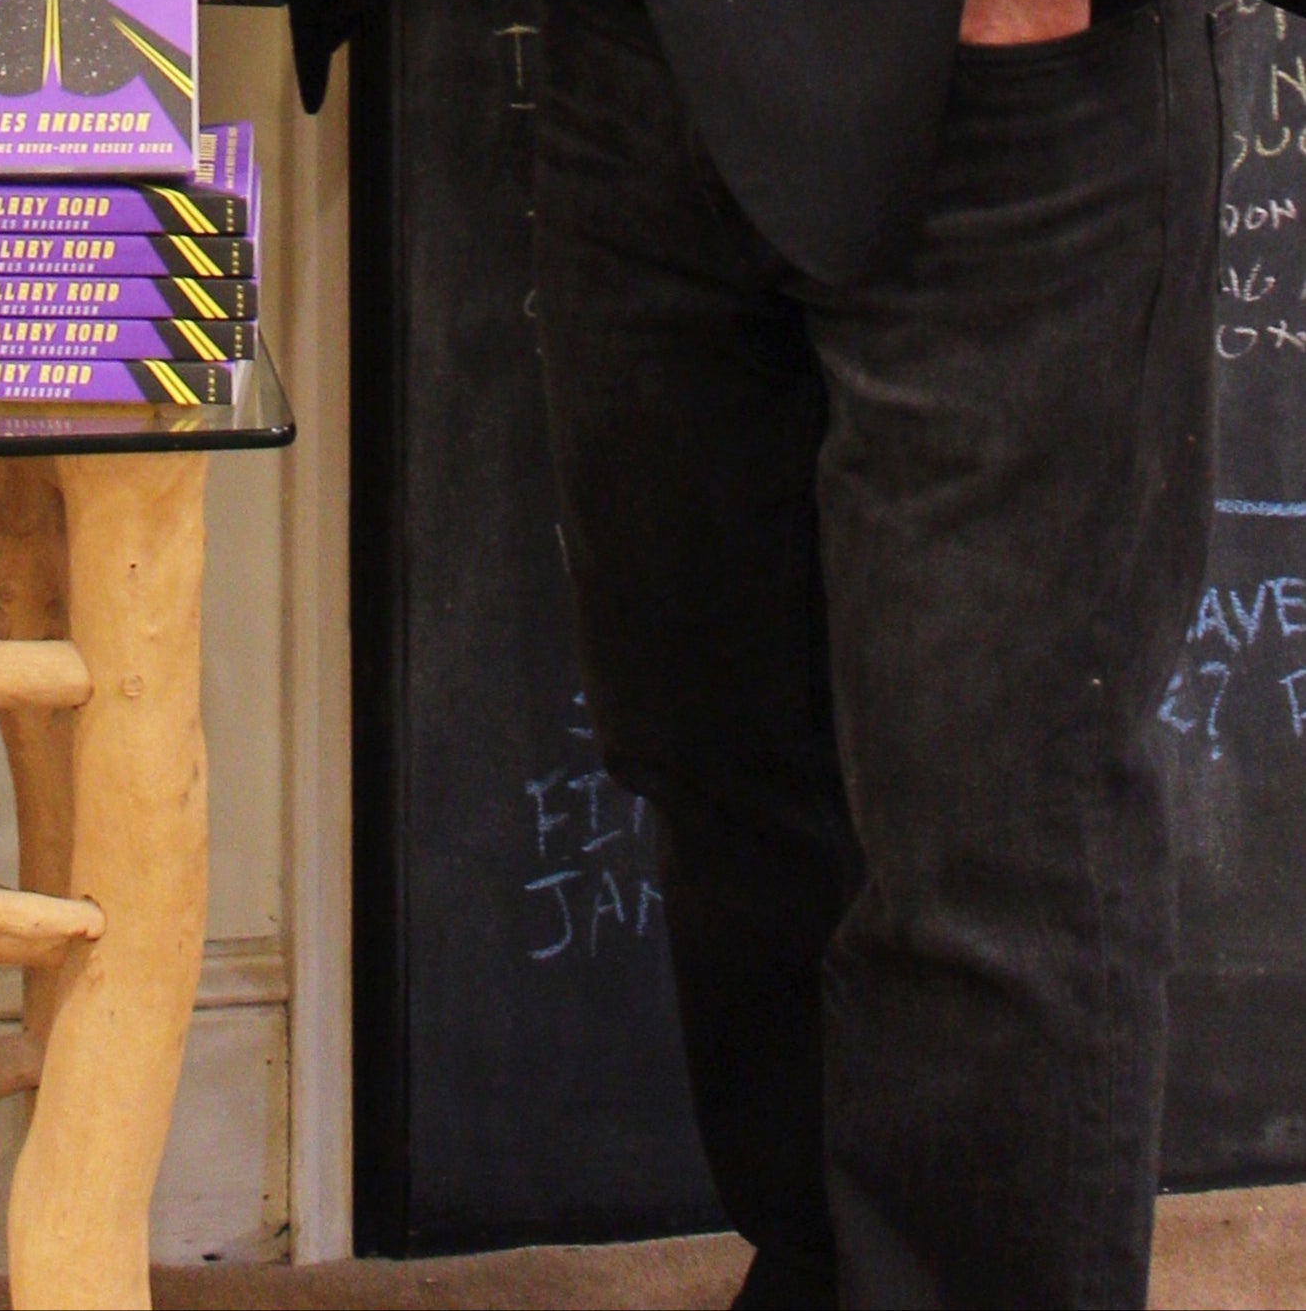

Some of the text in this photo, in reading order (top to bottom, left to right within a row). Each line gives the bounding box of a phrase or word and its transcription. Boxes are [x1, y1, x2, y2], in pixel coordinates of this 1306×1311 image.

[36, 111, 152, 134] ANDERSON
[92, 141, 134, 154] DESERT
[57, 196, 111, 217] ROAD
[62, 238, 115, 259] ROAD
[66, 281, 120, 302] ROAD
[65, 322, 119, 343] ROAD
[38, 362, 92, 383] ROAD
